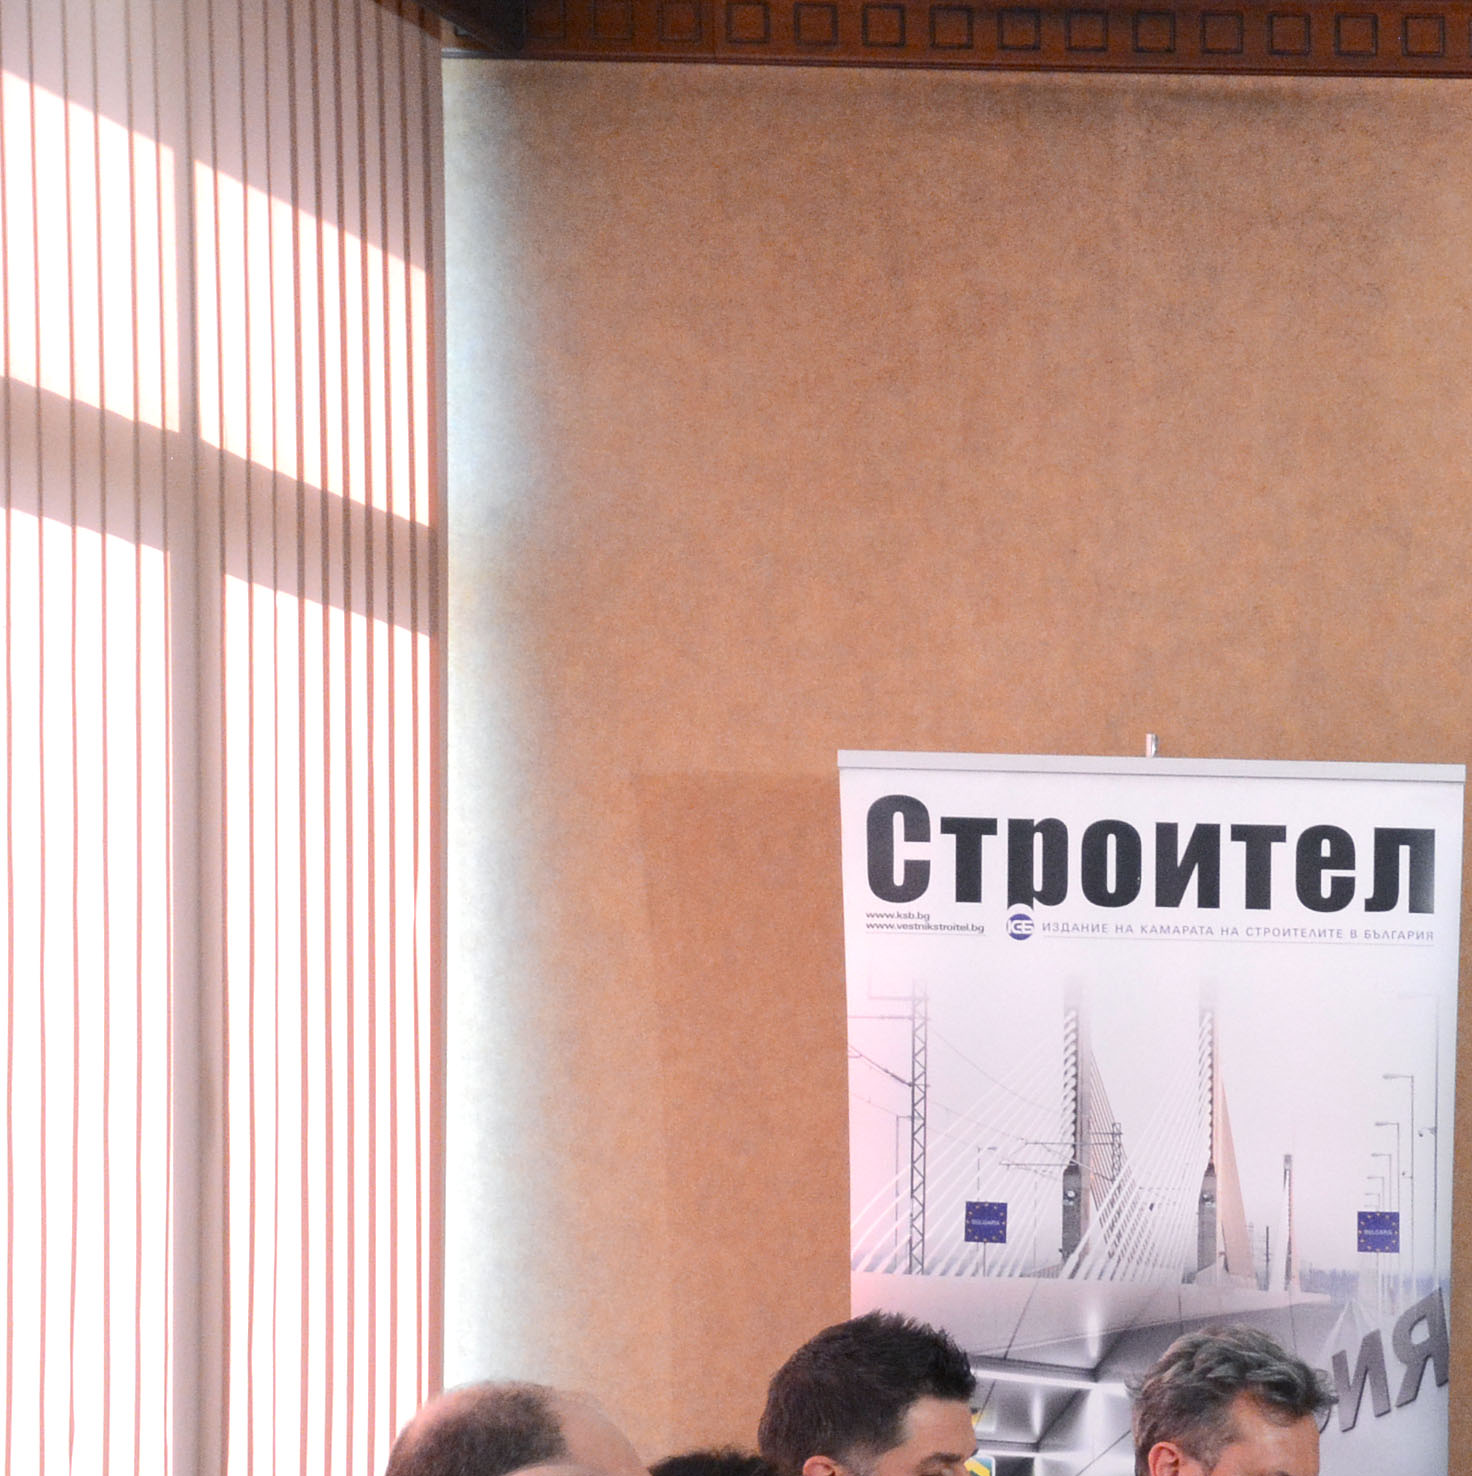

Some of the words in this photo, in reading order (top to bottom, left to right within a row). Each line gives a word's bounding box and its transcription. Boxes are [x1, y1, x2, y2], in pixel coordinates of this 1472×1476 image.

[865, 793, 1436, 914] Строител
[865, 910, 931, 921] www.ksb.bg
[865, 920, 985, 934] www.vestnikstroitel.bg
[1041, 922, 1109, 934] ИЗДАНИЕ
[1115, 923, 1134, 935] НА
[1140, 924, 1214, 937] КАМАРАТА
[1220, 926, 1240, 937] НА
[1245, 926, 1344, 940] СТРОИТЕЛИТЕ
[1349, 928, 1358, 939] В
[1363, 928, 1435, 941] БЪЛГАРИЯ
[1315, 1286, 1449, 1435] ИЯ
